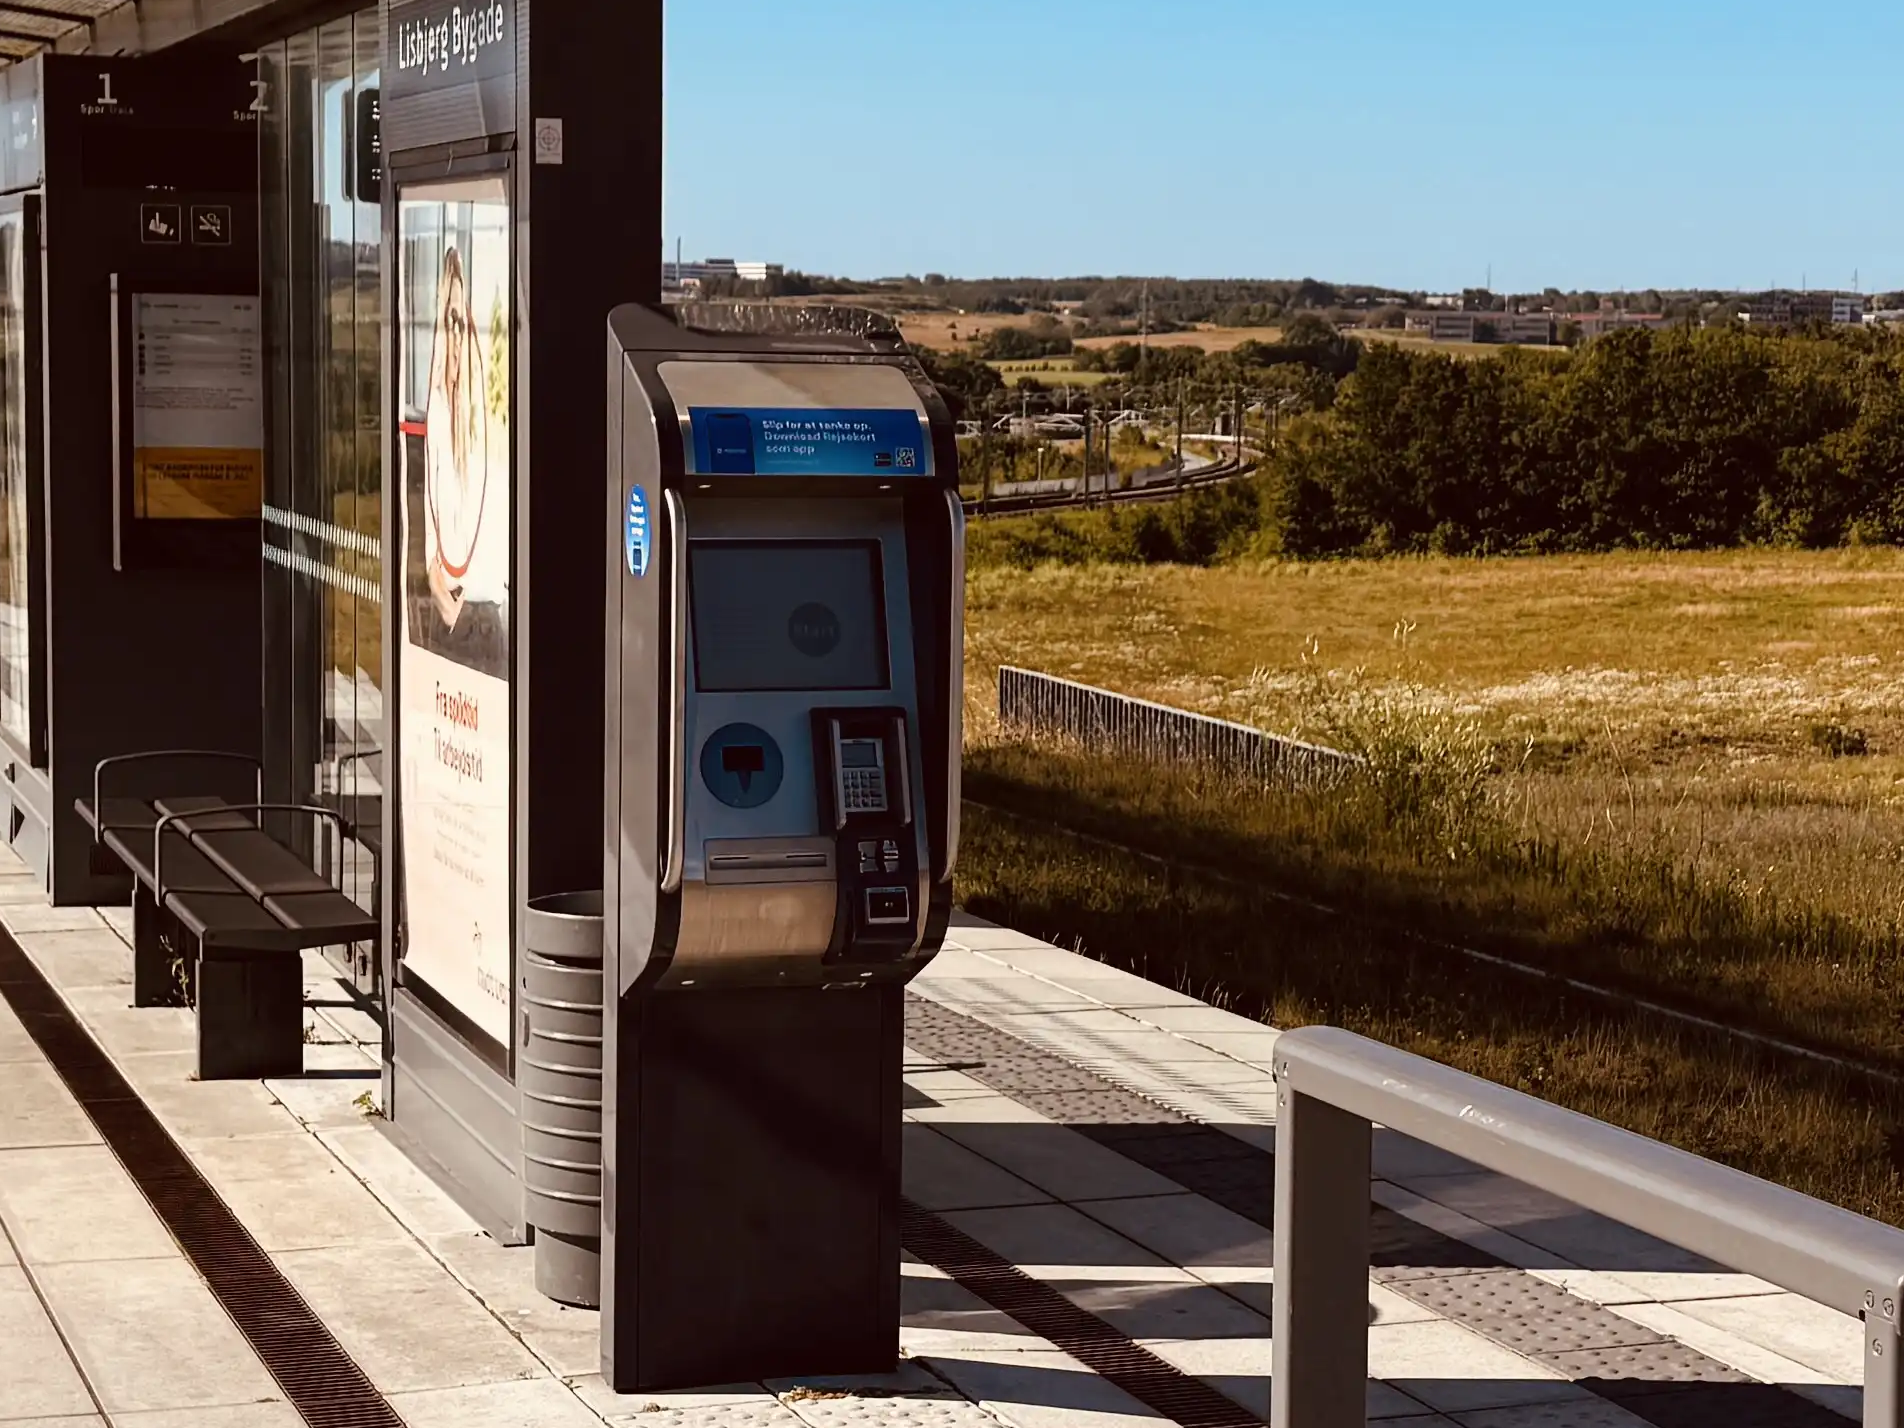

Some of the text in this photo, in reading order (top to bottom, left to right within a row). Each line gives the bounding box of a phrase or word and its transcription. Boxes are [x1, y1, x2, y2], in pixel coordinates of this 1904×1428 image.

[398, 16, 449, 77] Lisbjerg
[97, 72, 118, 104] 1
[249, 79, 269, 111] 2
